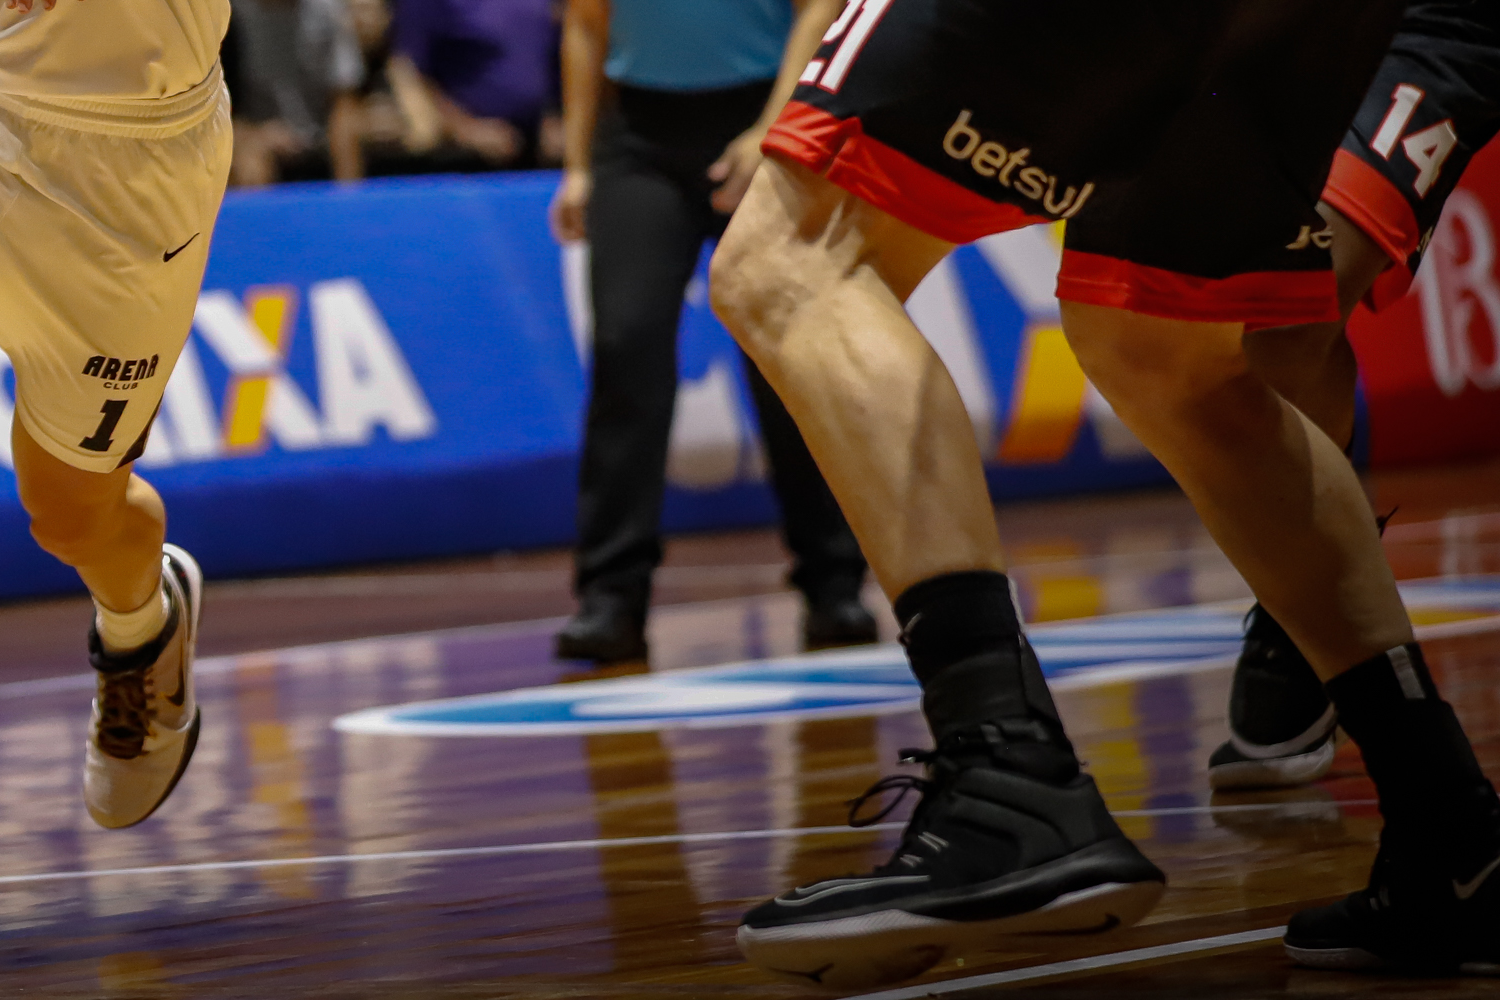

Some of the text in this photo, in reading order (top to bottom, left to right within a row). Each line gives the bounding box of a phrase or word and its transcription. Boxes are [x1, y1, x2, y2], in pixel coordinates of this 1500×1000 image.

[942, 109, 1096, 219] betsul
[1368, 82, 1458, 200] 14
[81, 353, 159, 381] ARENA
[103, 382, 139, 390] CLUB
[78, 399, 130, 452] 1
